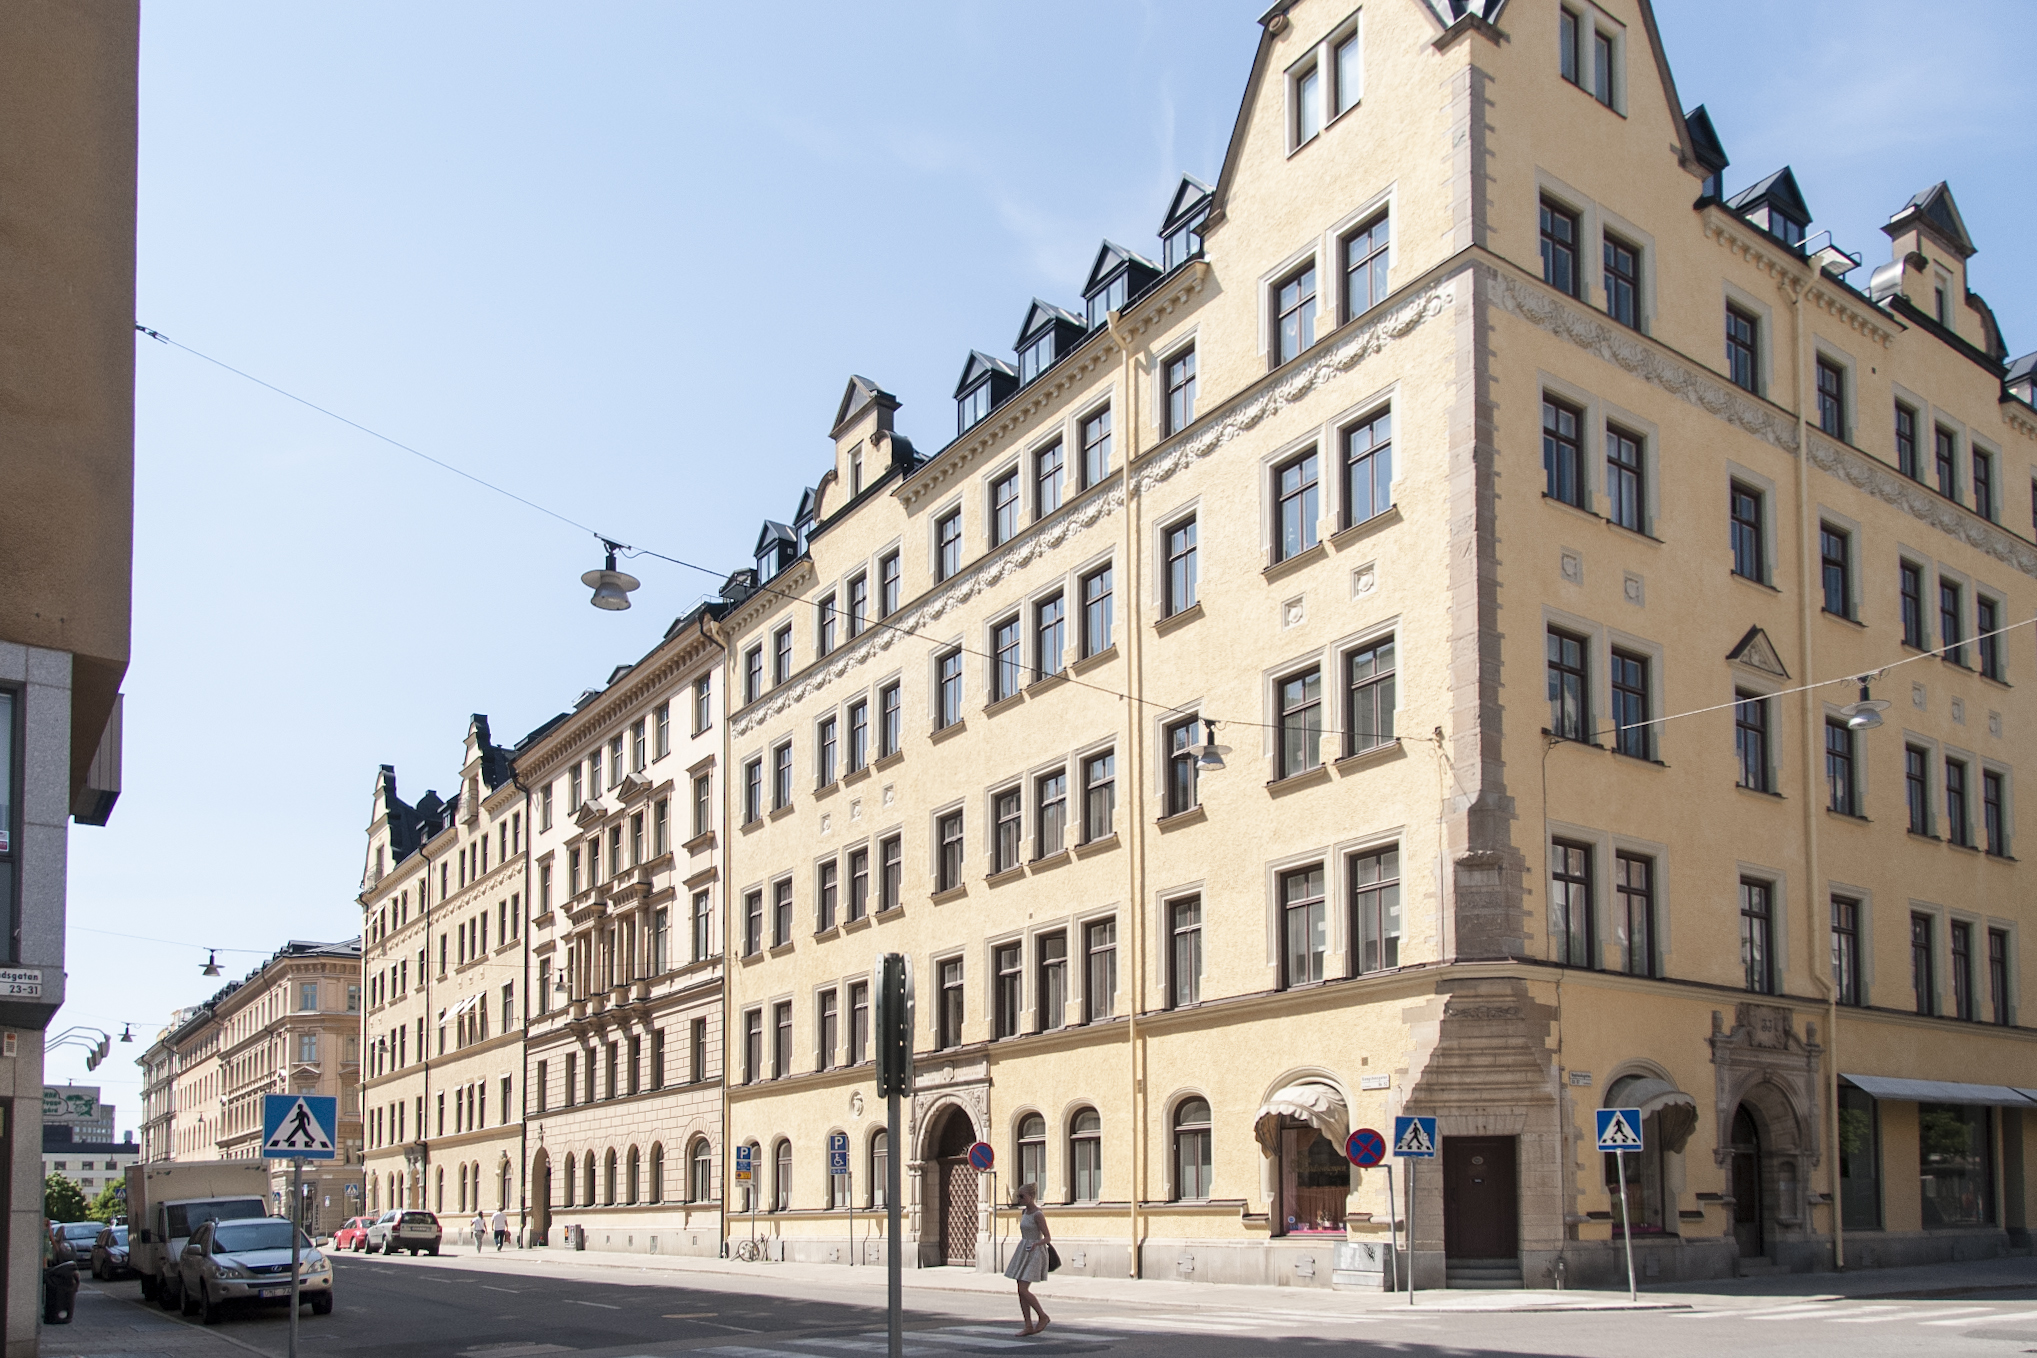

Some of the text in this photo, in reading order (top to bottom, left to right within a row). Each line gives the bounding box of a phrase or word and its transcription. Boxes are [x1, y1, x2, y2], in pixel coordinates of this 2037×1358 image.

[0, 971, 39, 982] dsgatan
[9, 984, 39, 995] 23-31
[834, 1136, 844, 1150] P
[740, 1147, 749, 1159] P
